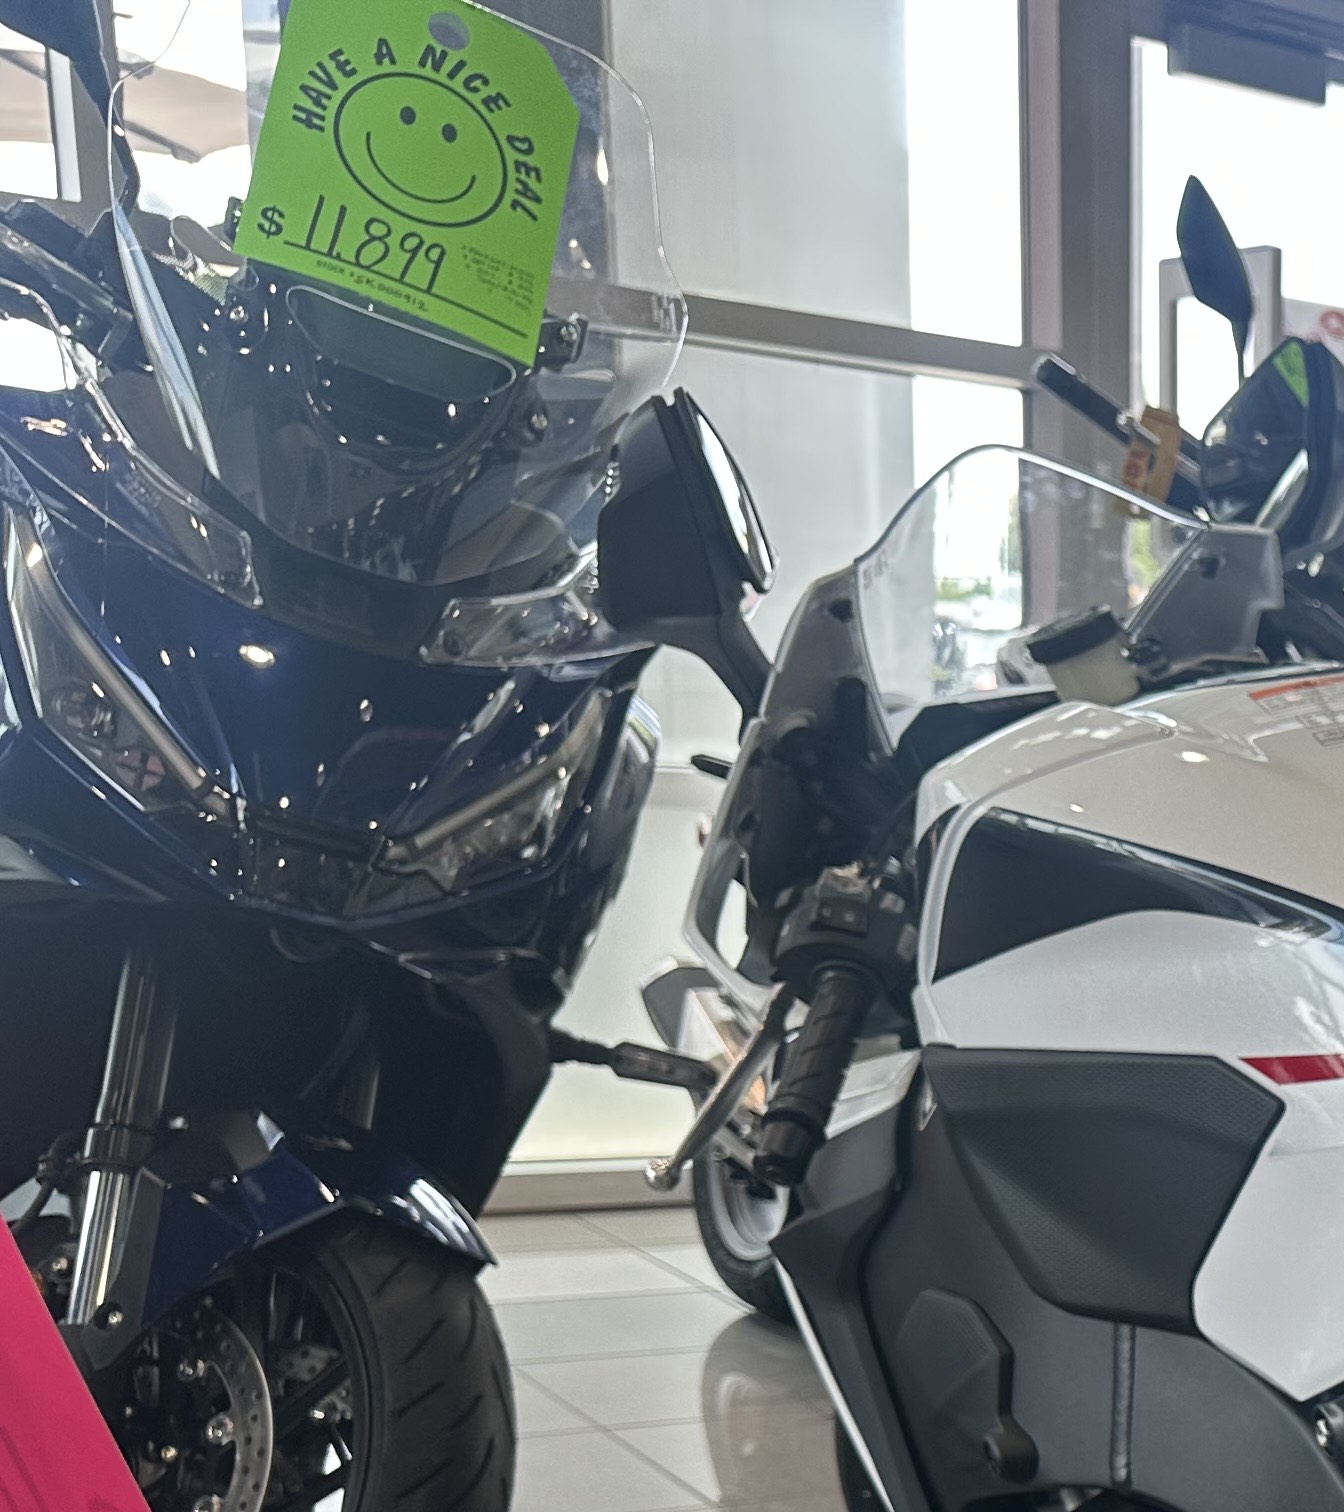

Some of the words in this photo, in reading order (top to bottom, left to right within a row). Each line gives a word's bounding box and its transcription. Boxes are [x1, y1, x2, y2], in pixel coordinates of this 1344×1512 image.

[292, 48, 358, 133] HAVE
[373, 37, 397, 66] A
[417, 43, 512, 113] NICE
[505, 134, 543, 222] DEAL
[257, 205, 285, 239] $
